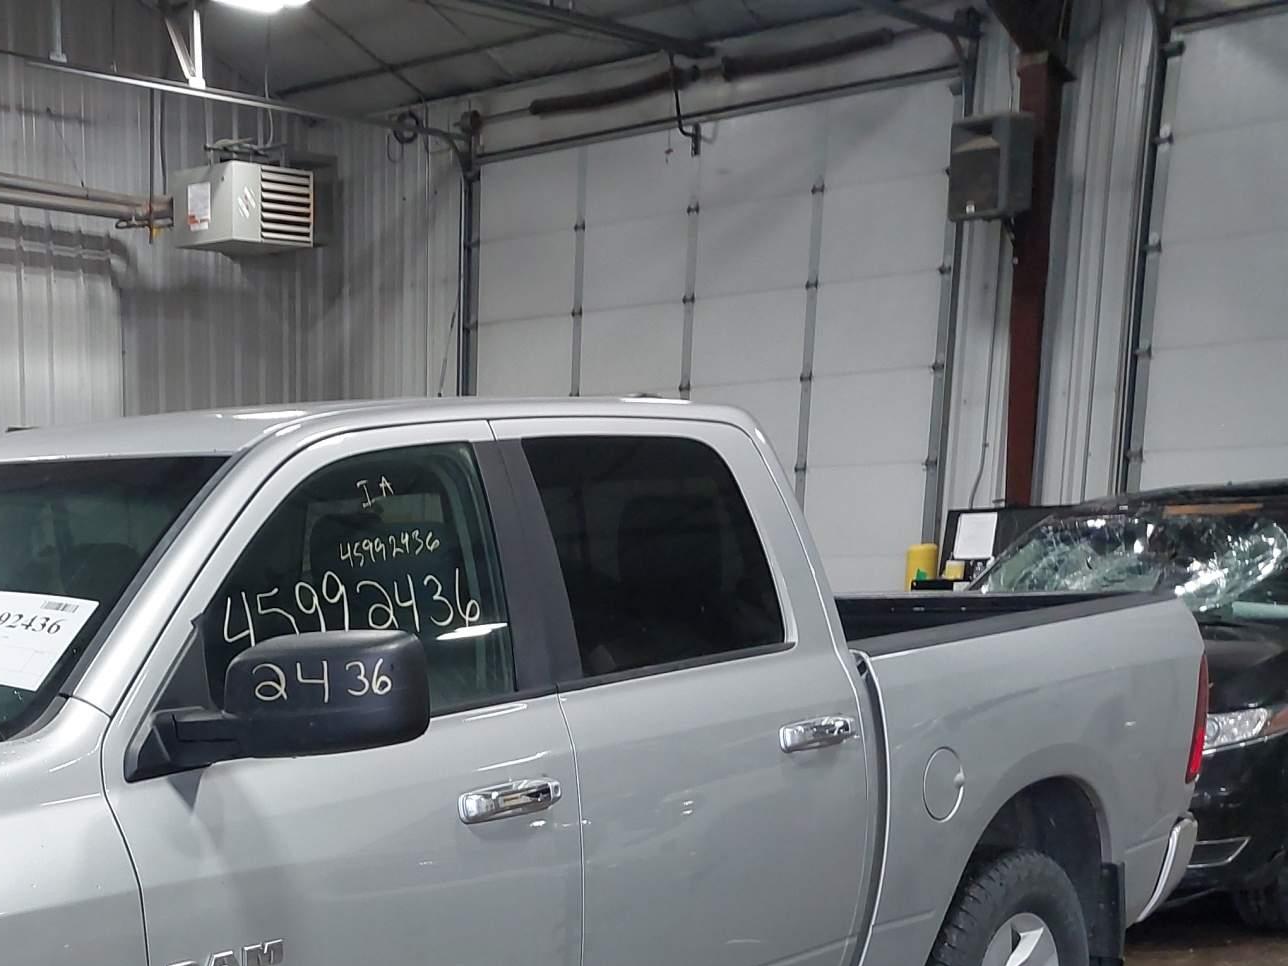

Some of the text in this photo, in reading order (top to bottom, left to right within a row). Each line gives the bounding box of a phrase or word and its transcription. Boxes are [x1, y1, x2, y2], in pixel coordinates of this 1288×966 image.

[339, 529, 440, 568] 45992436
[223, 568, 481, 648] 45992436
[252, 658, 392, 704] 2436
